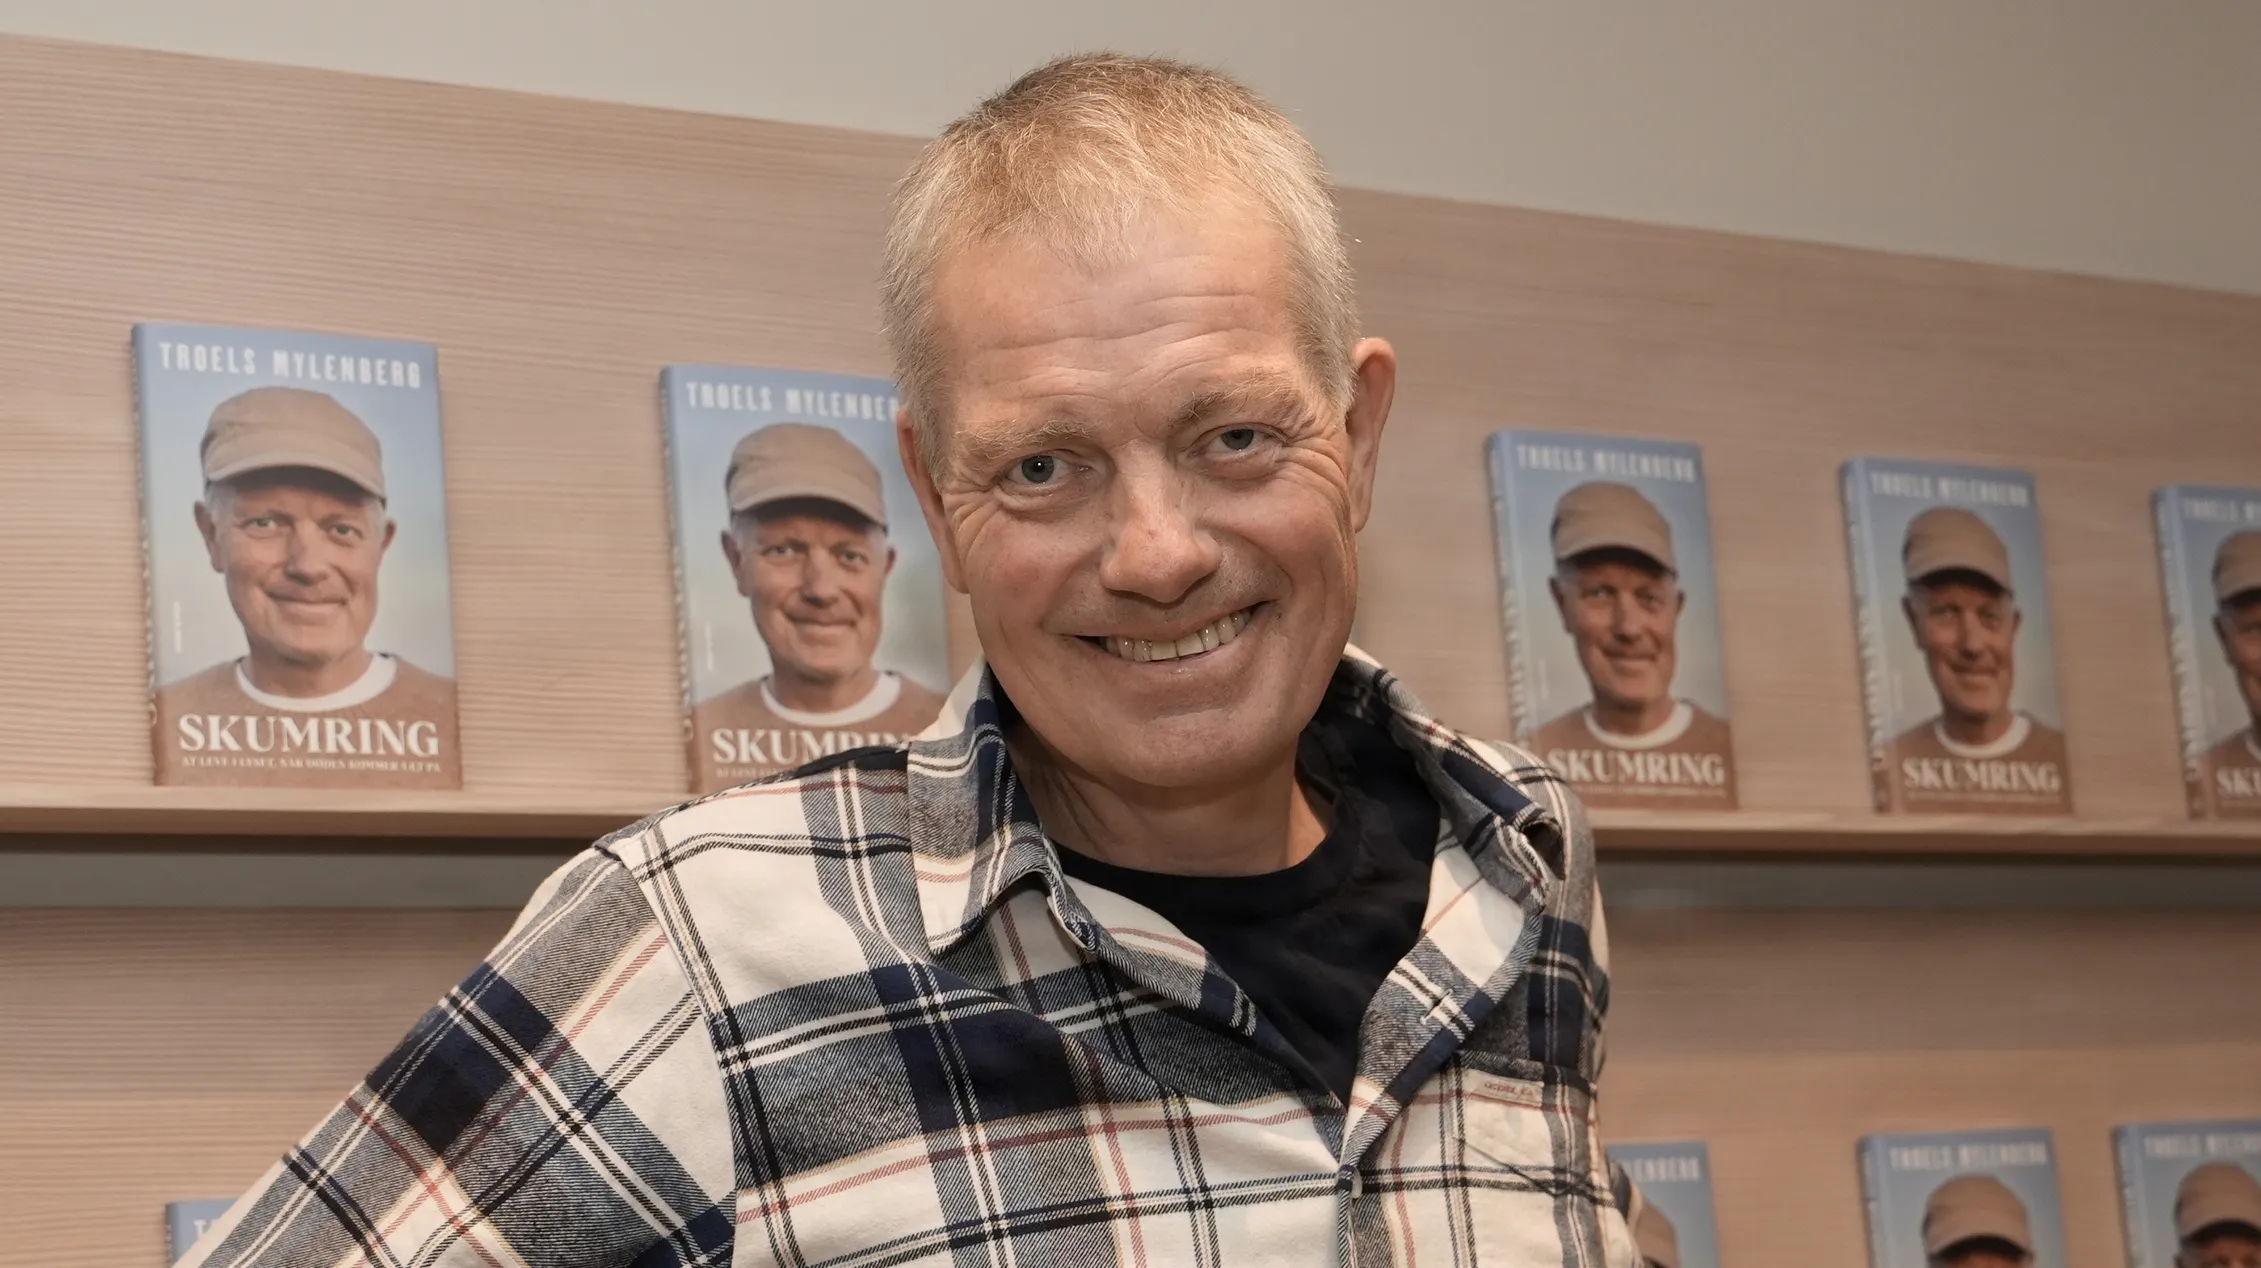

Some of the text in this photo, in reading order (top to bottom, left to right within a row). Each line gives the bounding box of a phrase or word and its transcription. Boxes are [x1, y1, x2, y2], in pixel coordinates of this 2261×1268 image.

[159, 342, 422, 389] TROELS MYLENBERG
[686, 381, 772, 412] TROELS
[178, 713, 440, 758] SKUMRING
[1547, 748, 1726, 786] SKUMRING
[1902, 757, 2062, 793] SKUMRING
